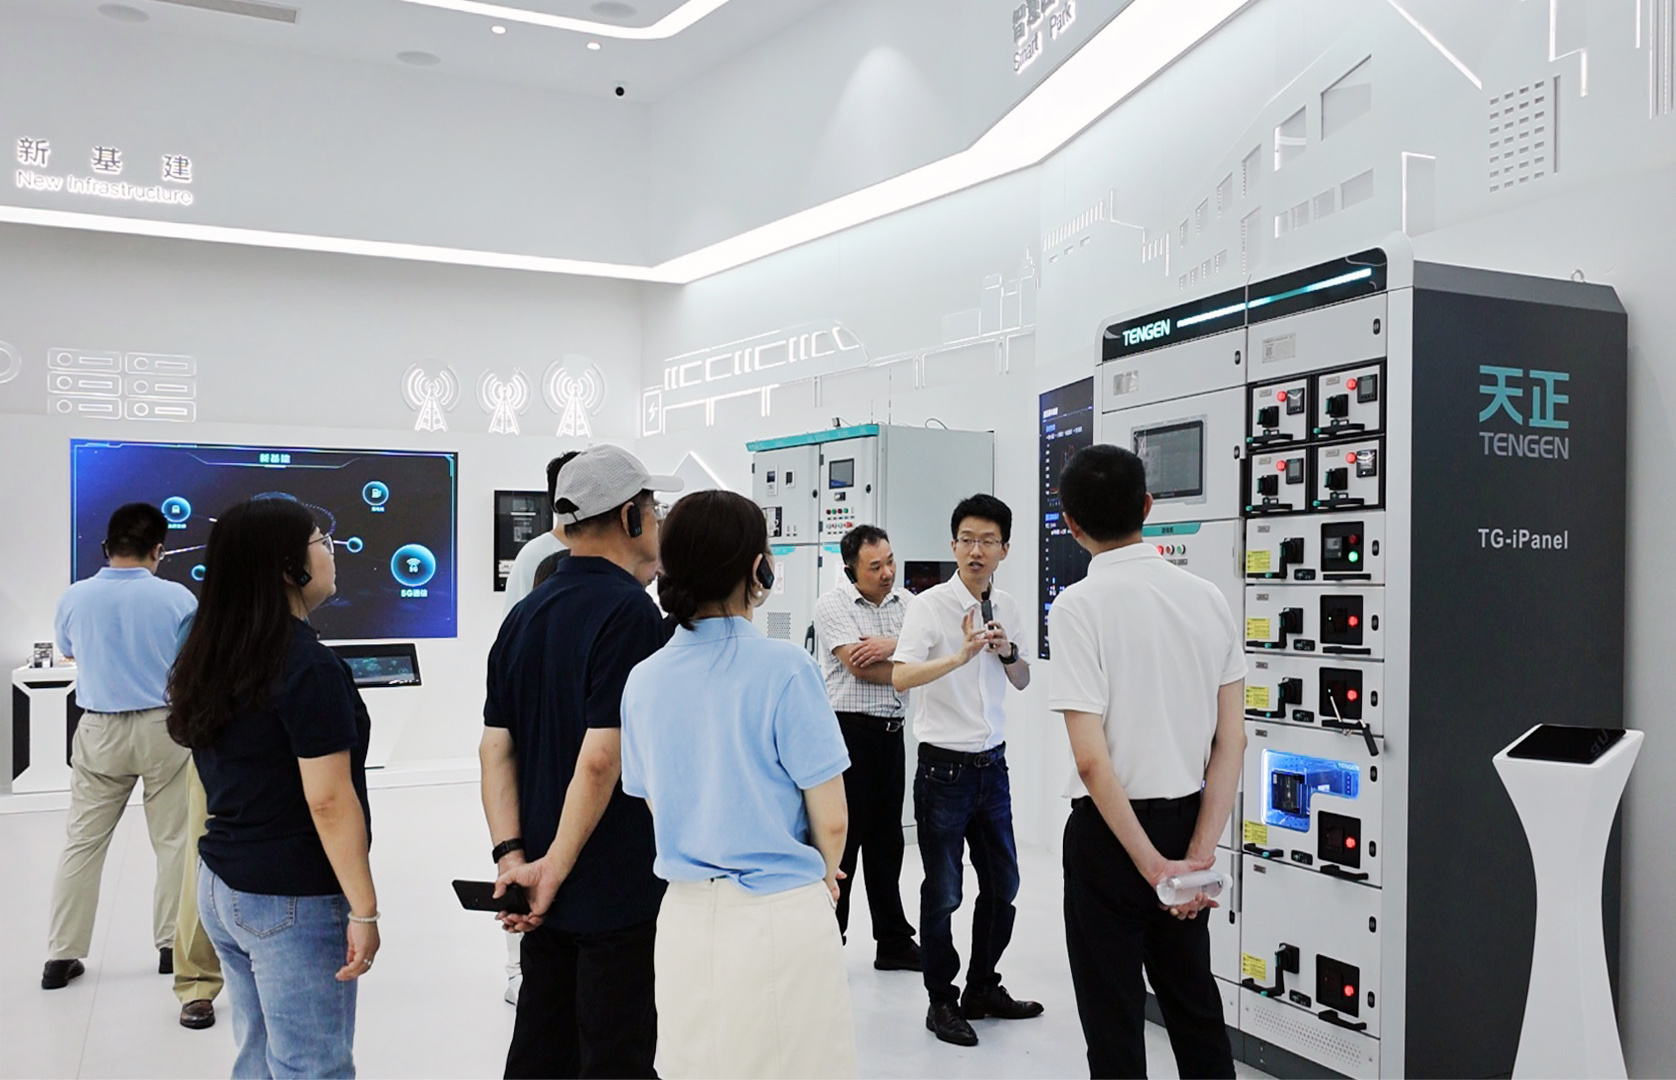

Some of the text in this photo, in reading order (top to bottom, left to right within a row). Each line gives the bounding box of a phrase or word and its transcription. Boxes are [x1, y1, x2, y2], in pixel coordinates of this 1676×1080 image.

[1013, 1, 1073, 73] Smart Park
[18, 136, 192, 183] 新基建
[16, 170, 194, 206] New Infrastructure
[1122, 318, 1171, 347] TENGEN
[1479, 365, 1570, 429] 天正
[1479, 431, 1569, 459] TENGEN
[1478, 528, 1569, 549] TG-iPanel
